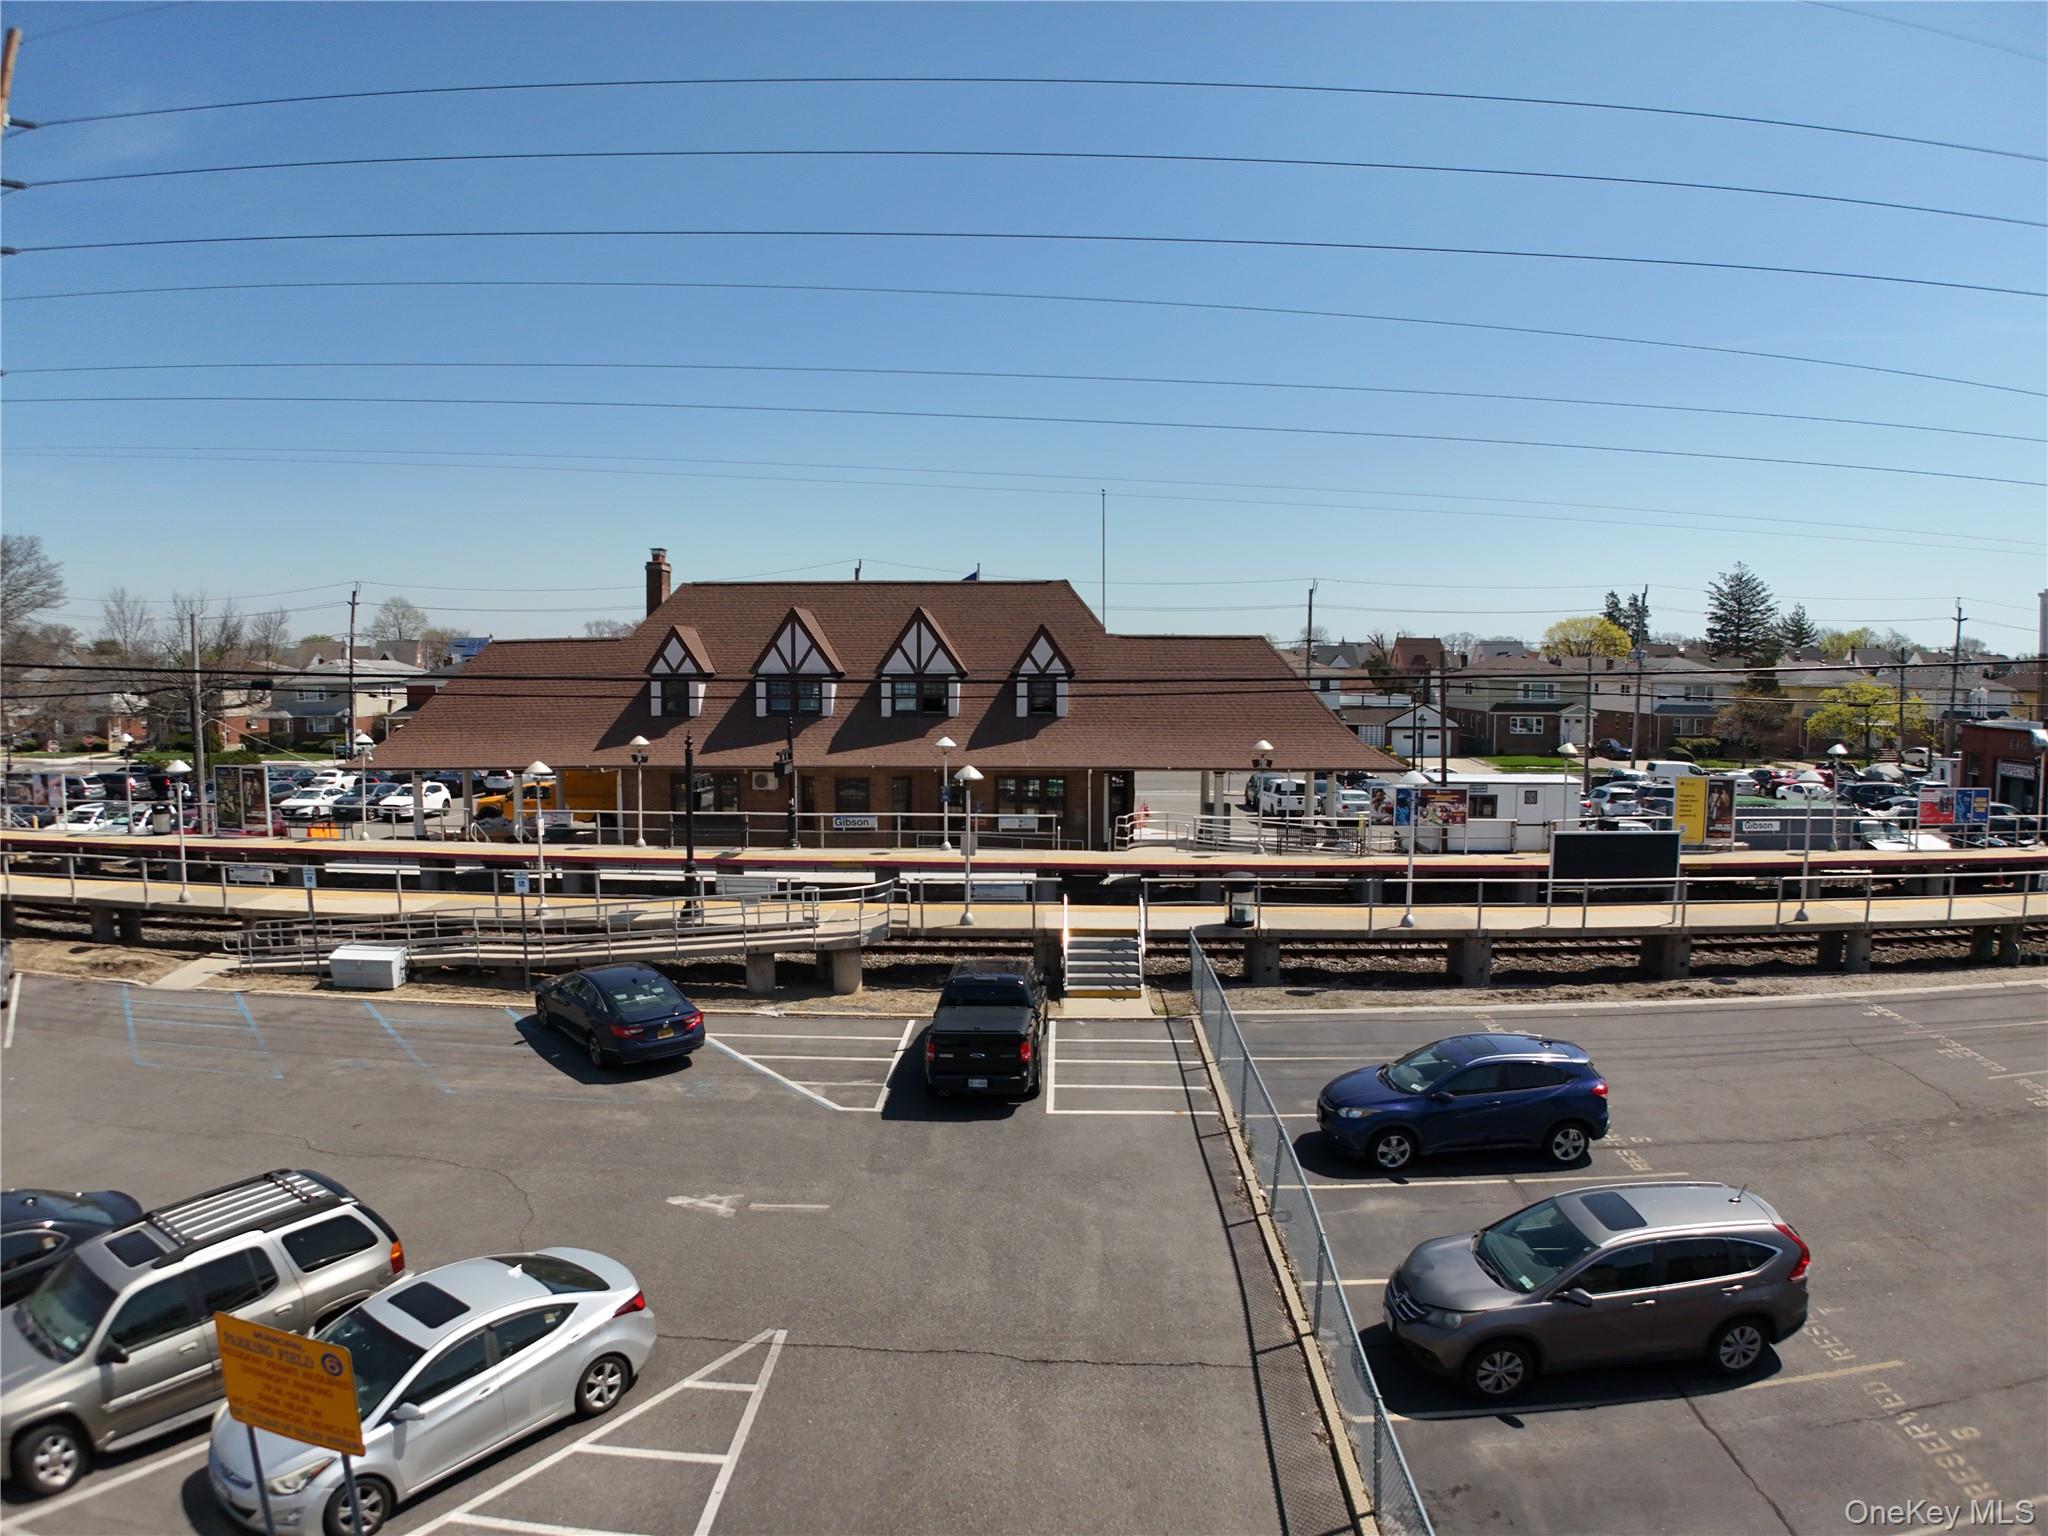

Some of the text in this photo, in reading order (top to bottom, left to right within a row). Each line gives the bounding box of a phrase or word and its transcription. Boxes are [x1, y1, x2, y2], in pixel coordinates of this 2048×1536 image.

[835, 817, 869, 826] Gibson
[1744, 820, 1773, 830] Gibson
[223, 1332, 314, 1369] PARKING FIELD
[1863, 1381, 1999, 1499] RESERVED
